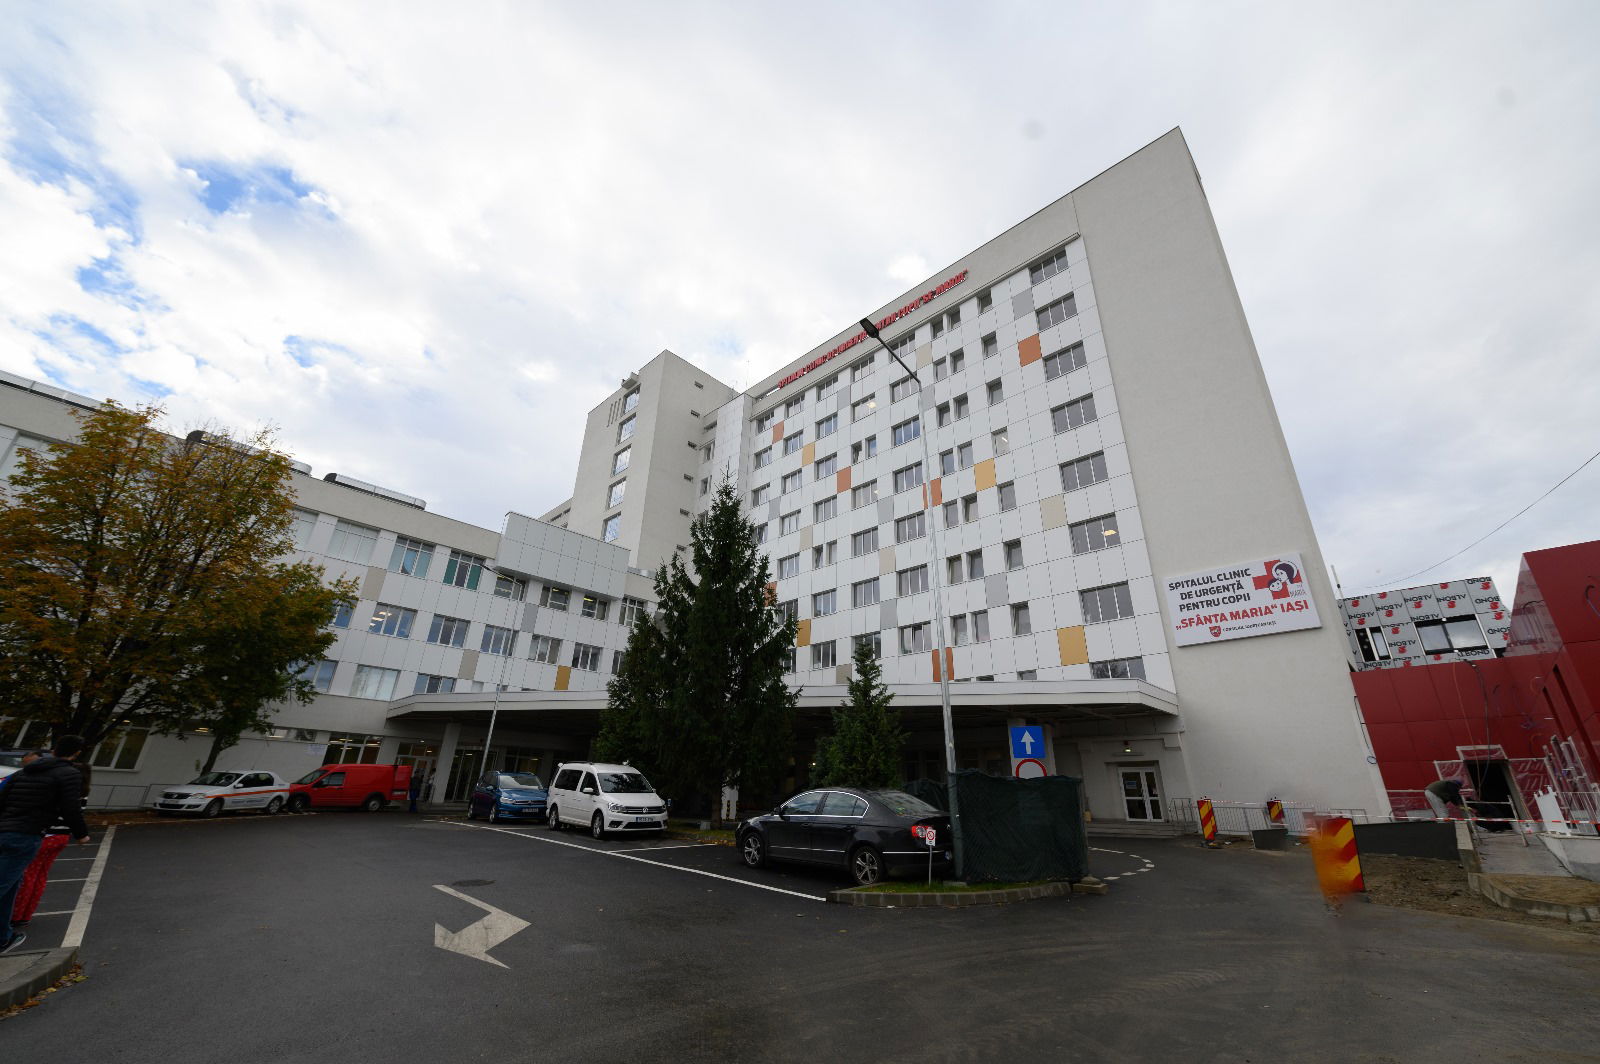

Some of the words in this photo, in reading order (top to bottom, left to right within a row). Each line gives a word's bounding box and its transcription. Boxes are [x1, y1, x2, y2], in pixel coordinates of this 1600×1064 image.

[1169, 575, 1216, 591] SPITALUL
[1218, 568, 1251, 582] CLINIC
[1179, 597, 1220, 612] PENTRU
[1222, 593, 1250, 606] COPII
[1180, 589, 1193, 600] DE
